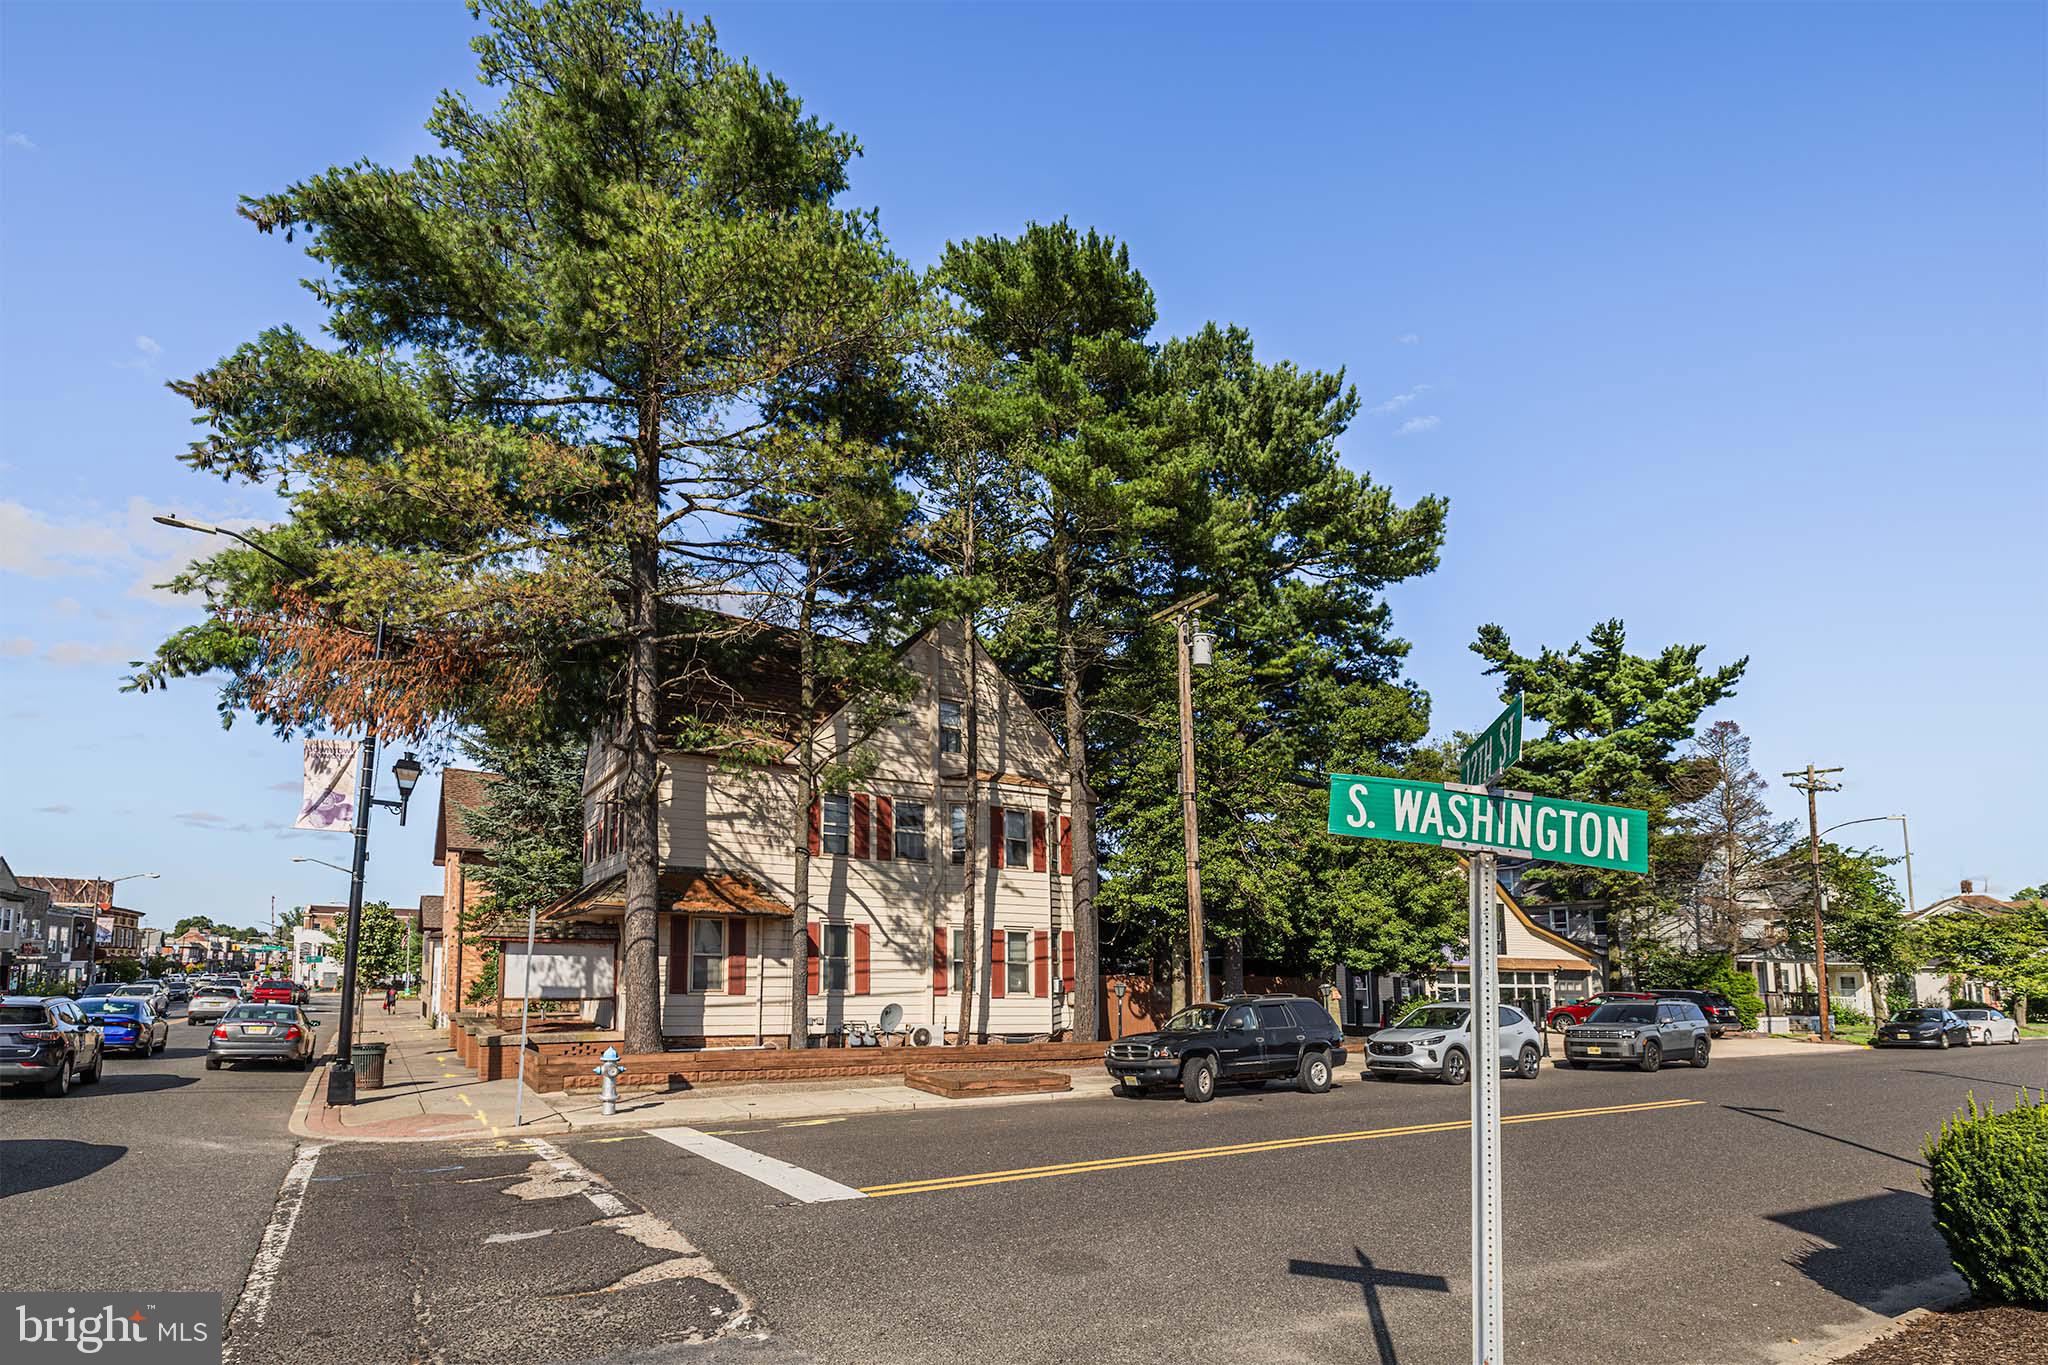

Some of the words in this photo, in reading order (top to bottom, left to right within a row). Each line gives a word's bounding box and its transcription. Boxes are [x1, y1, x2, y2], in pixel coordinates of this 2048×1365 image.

[1466, 735, 1492, 785] 12TH
[1499, 712, 1516, 767] ST
[1346, 783, 1376, 829] S.
[1393, 788, 1629, 862] WASHINGTON
